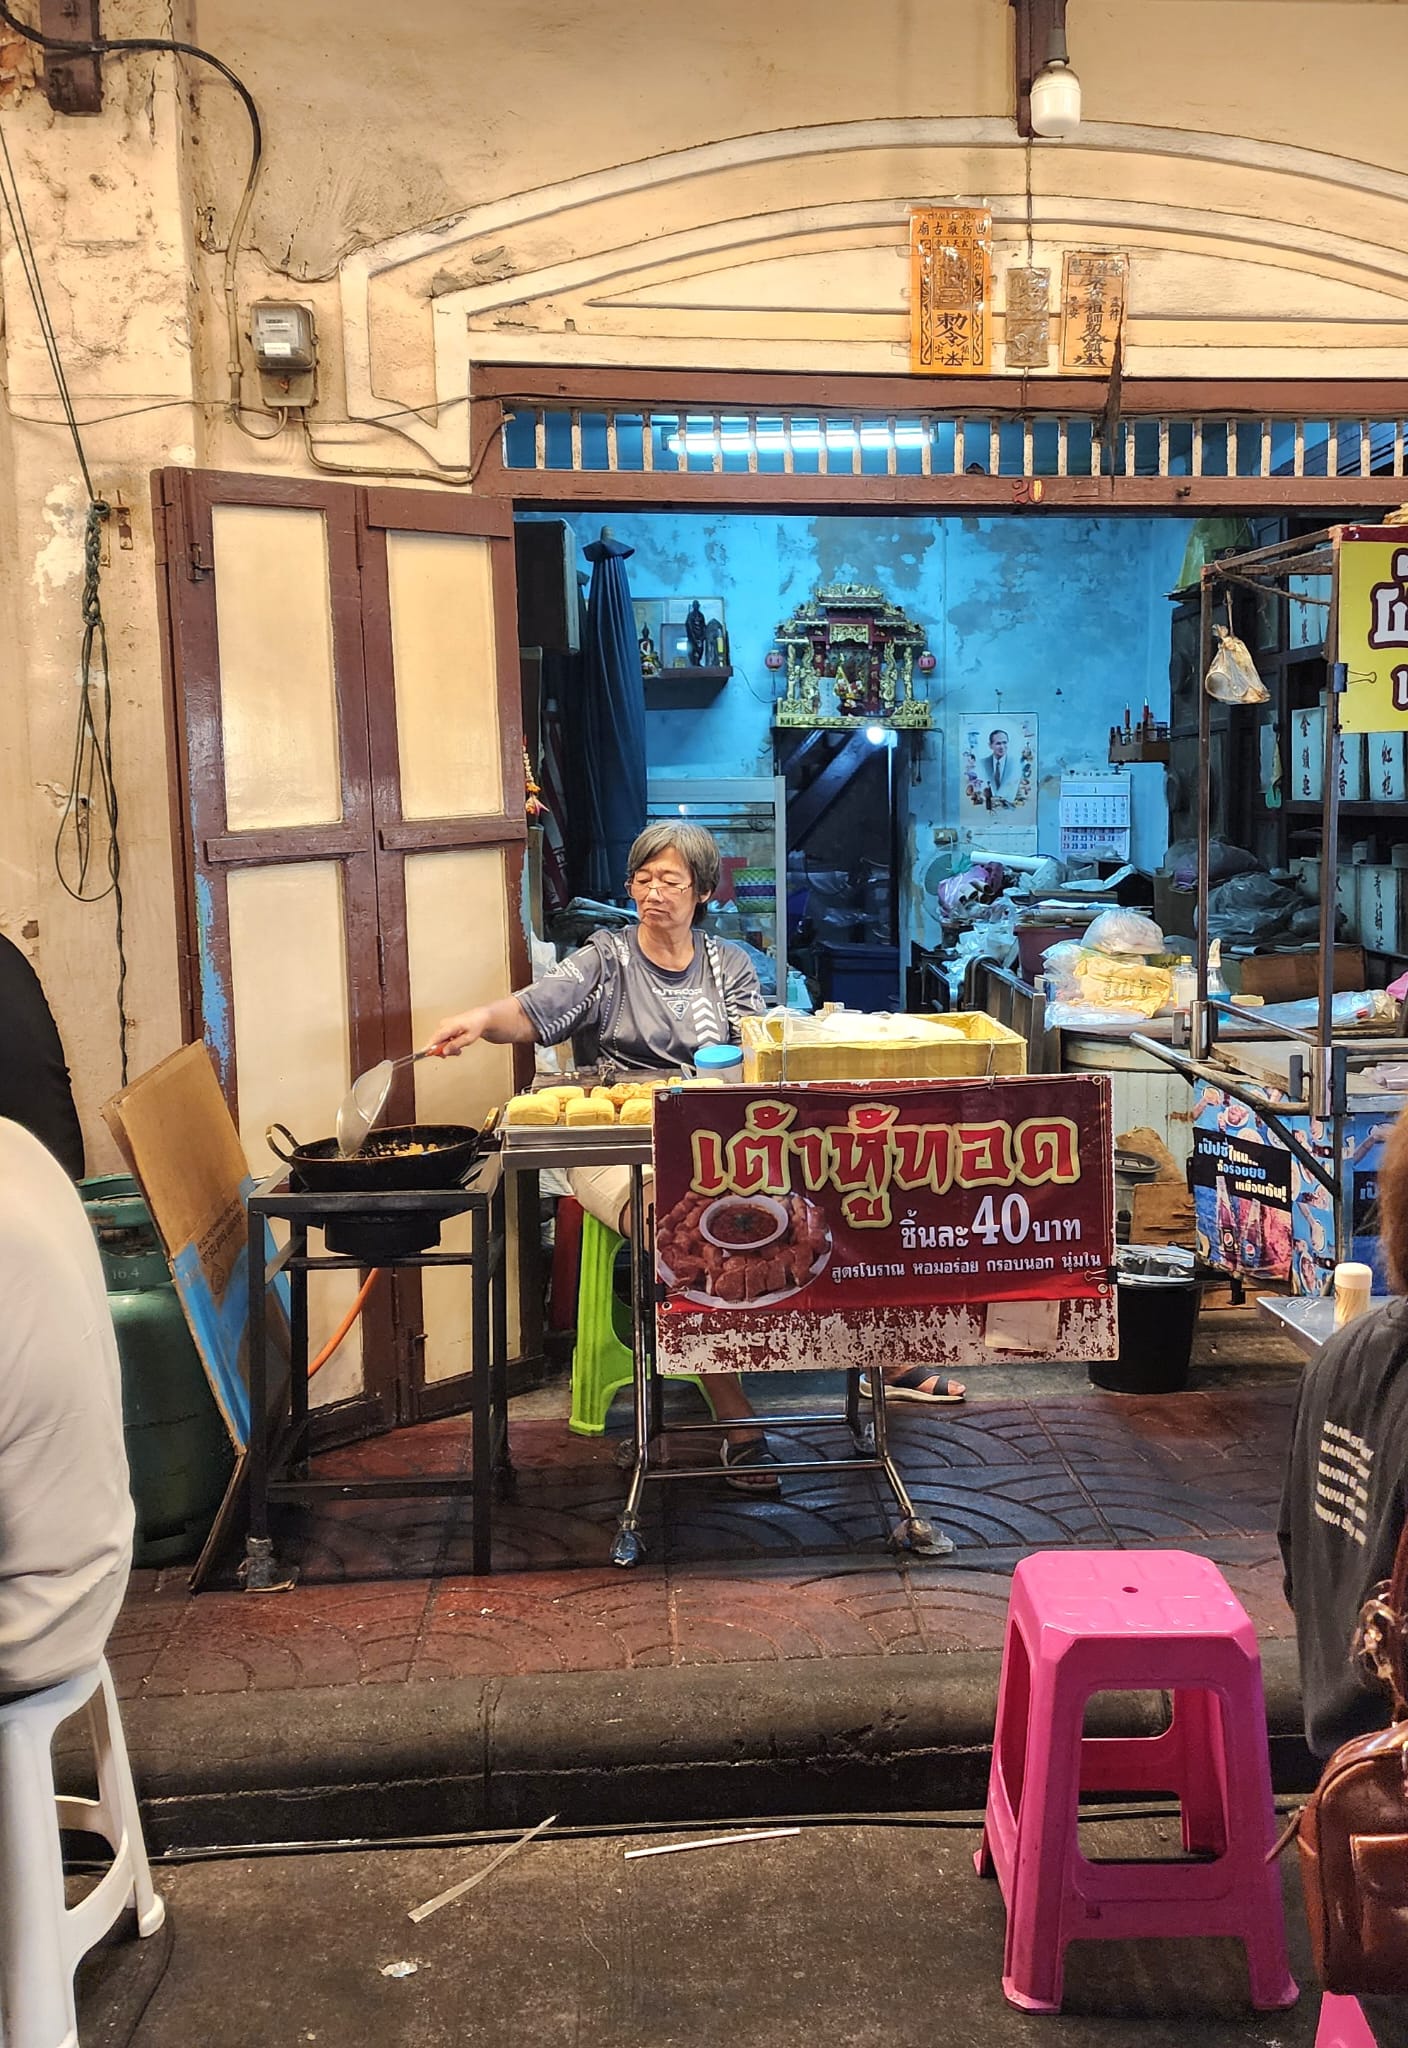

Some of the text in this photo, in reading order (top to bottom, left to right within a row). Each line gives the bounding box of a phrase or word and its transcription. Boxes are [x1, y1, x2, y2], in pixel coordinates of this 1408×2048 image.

[1012, 479, 1046, 504] 20
[691, 1100, 1081, 1228] เต้าหู้ทอด
[900, 1193, 1082, 1249] ชิ้นละ 40 บาท
[831, 1251, 1102, 1284] สูตรโบราณ หอมอร่อย กรอบนอก นุ่มใน
